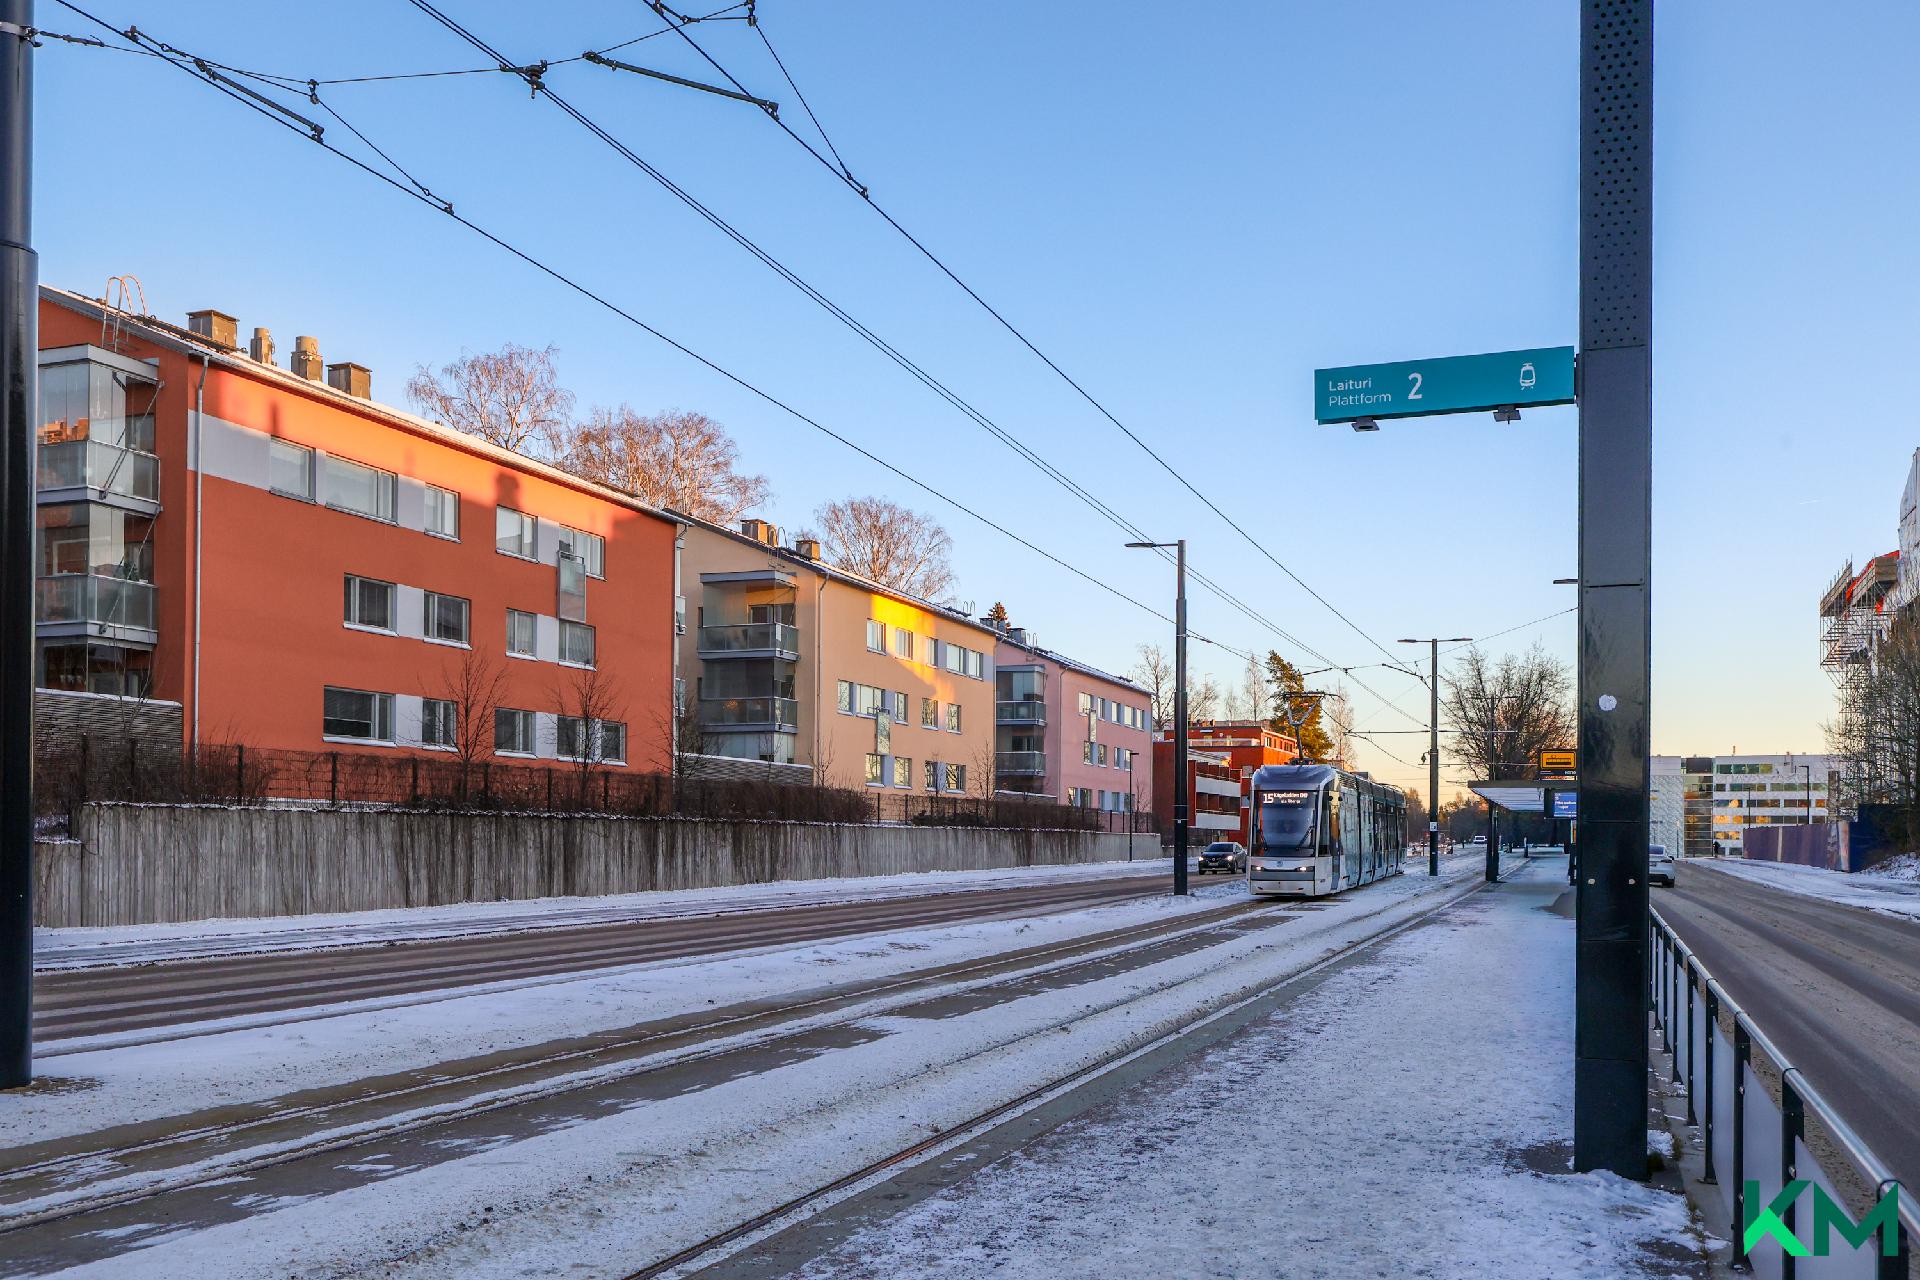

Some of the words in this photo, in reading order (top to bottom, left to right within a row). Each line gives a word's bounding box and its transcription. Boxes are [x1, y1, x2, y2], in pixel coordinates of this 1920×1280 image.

[1329, 378, 1371, 391] Laituri
[1408, 372, 1423, 400] 2
[1329, 393, 1392, 407] Plattform
[1263, 793, 1274, 804] 15
